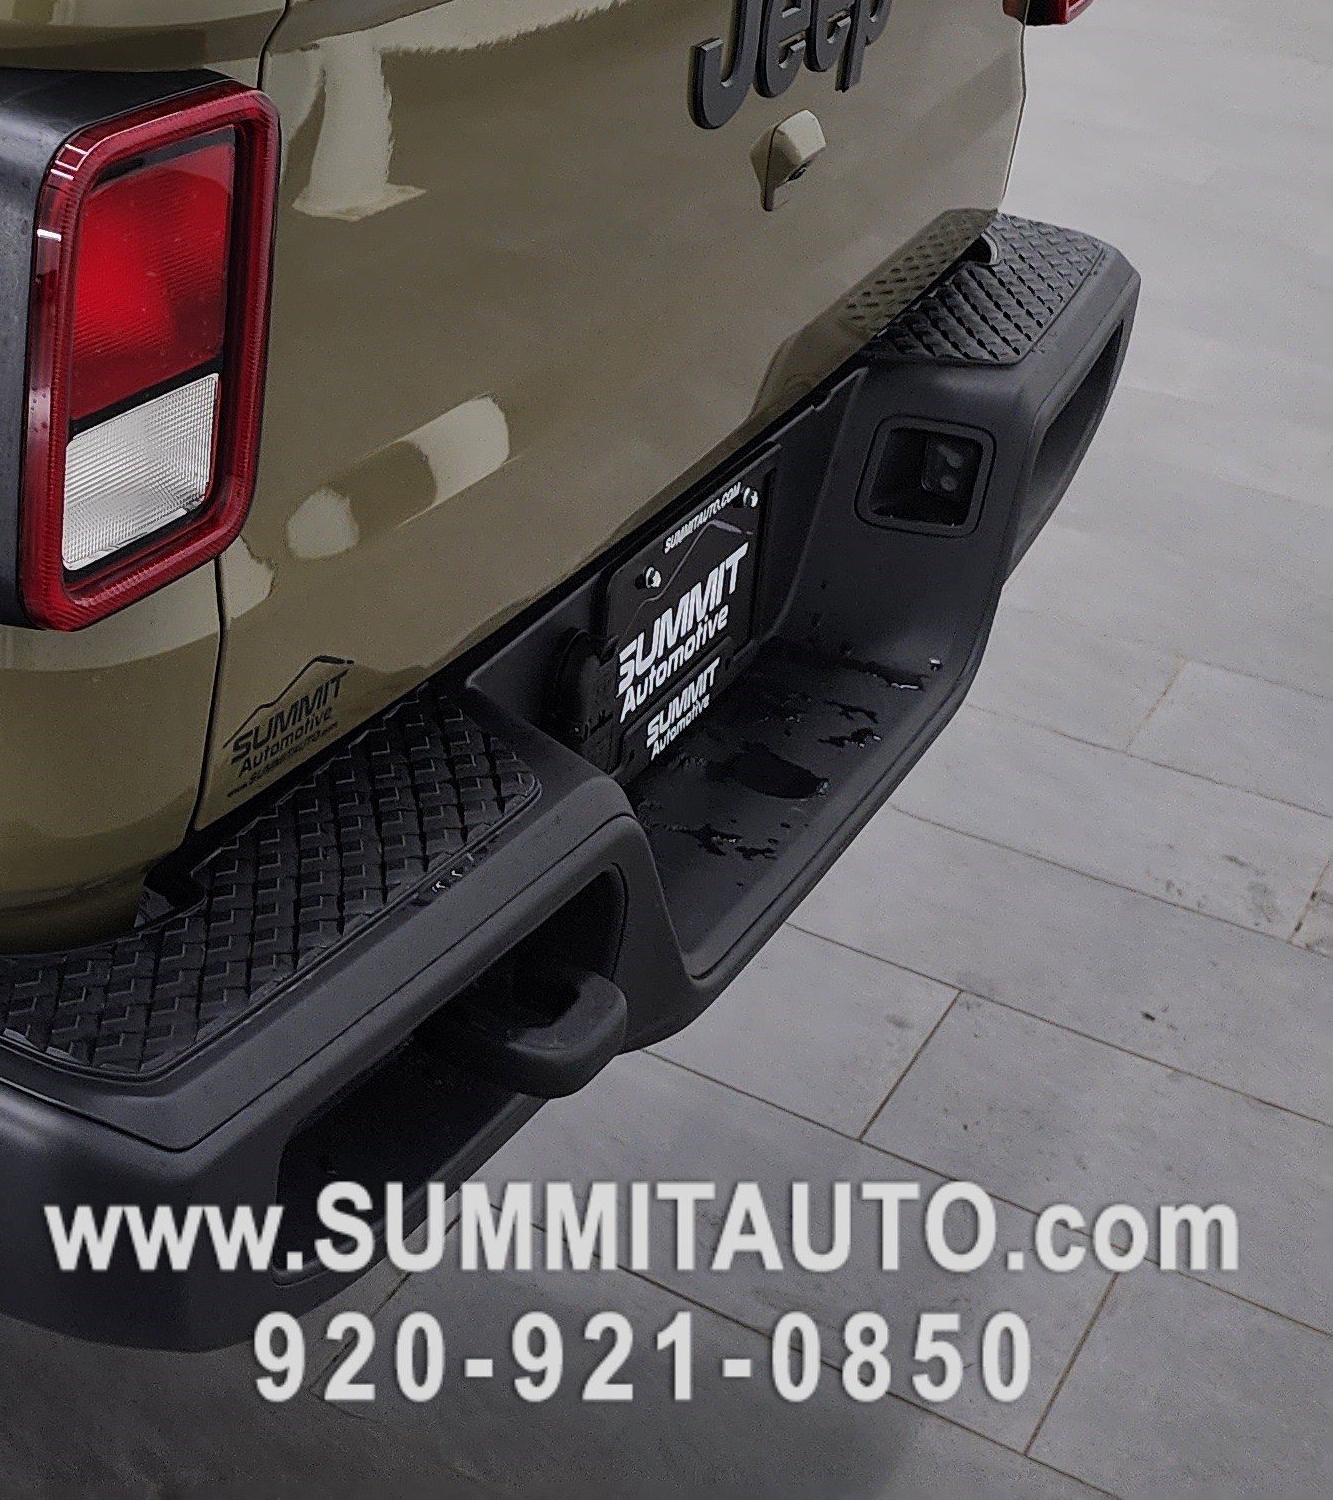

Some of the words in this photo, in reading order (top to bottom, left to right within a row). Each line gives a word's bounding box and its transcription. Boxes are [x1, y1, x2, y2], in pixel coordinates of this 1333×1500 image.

[616, 541, 750, 698] SUMMIT
[619, 603, 729, 723] Automotive
[230, 668, 350, 765] SUMMIT
[238, 706, 334, 778] Automotive
[646, 656, 720, 748] SUMMIT
[650, 692, 710, 761] Automotive
